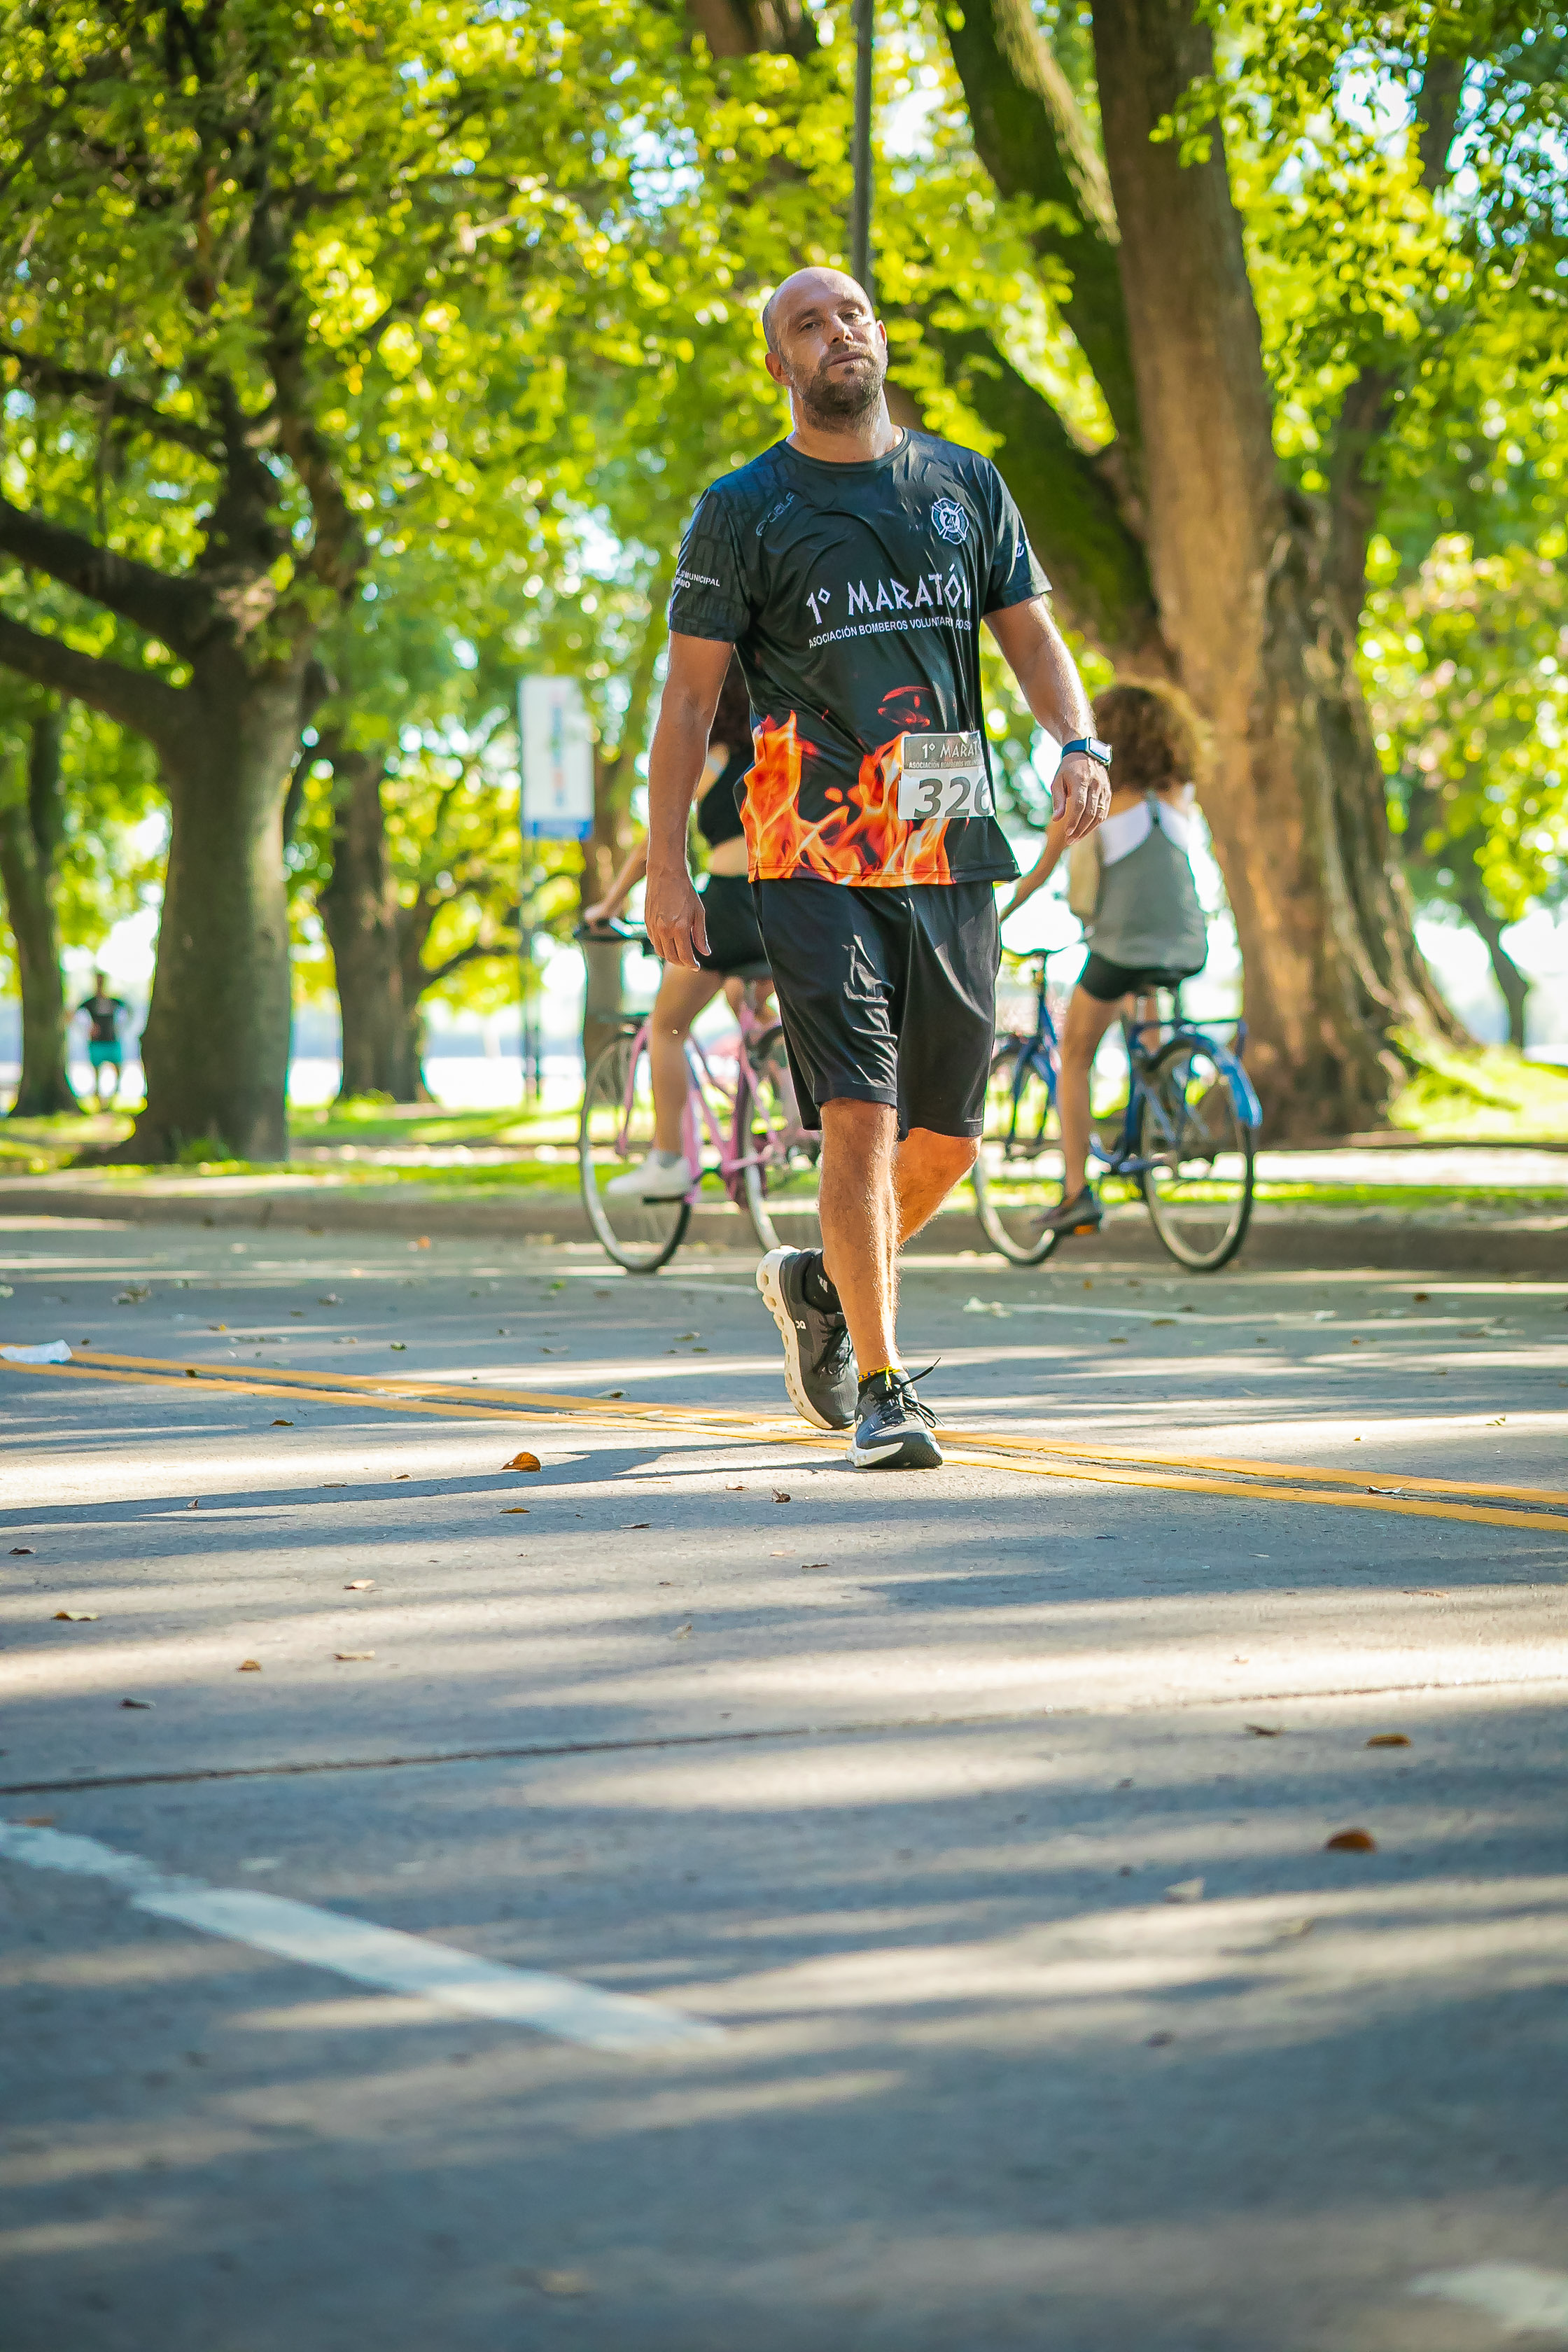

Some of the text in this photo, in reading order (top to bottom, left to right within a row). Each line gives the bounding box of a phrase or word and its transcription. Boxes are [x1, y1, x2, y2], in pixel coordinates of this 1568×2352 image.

[808, 625, 858, 649] ASOCIACIÓN
[858, 620, 909, 635] BOMBEROS
[913, 776, 991, 819] 326
